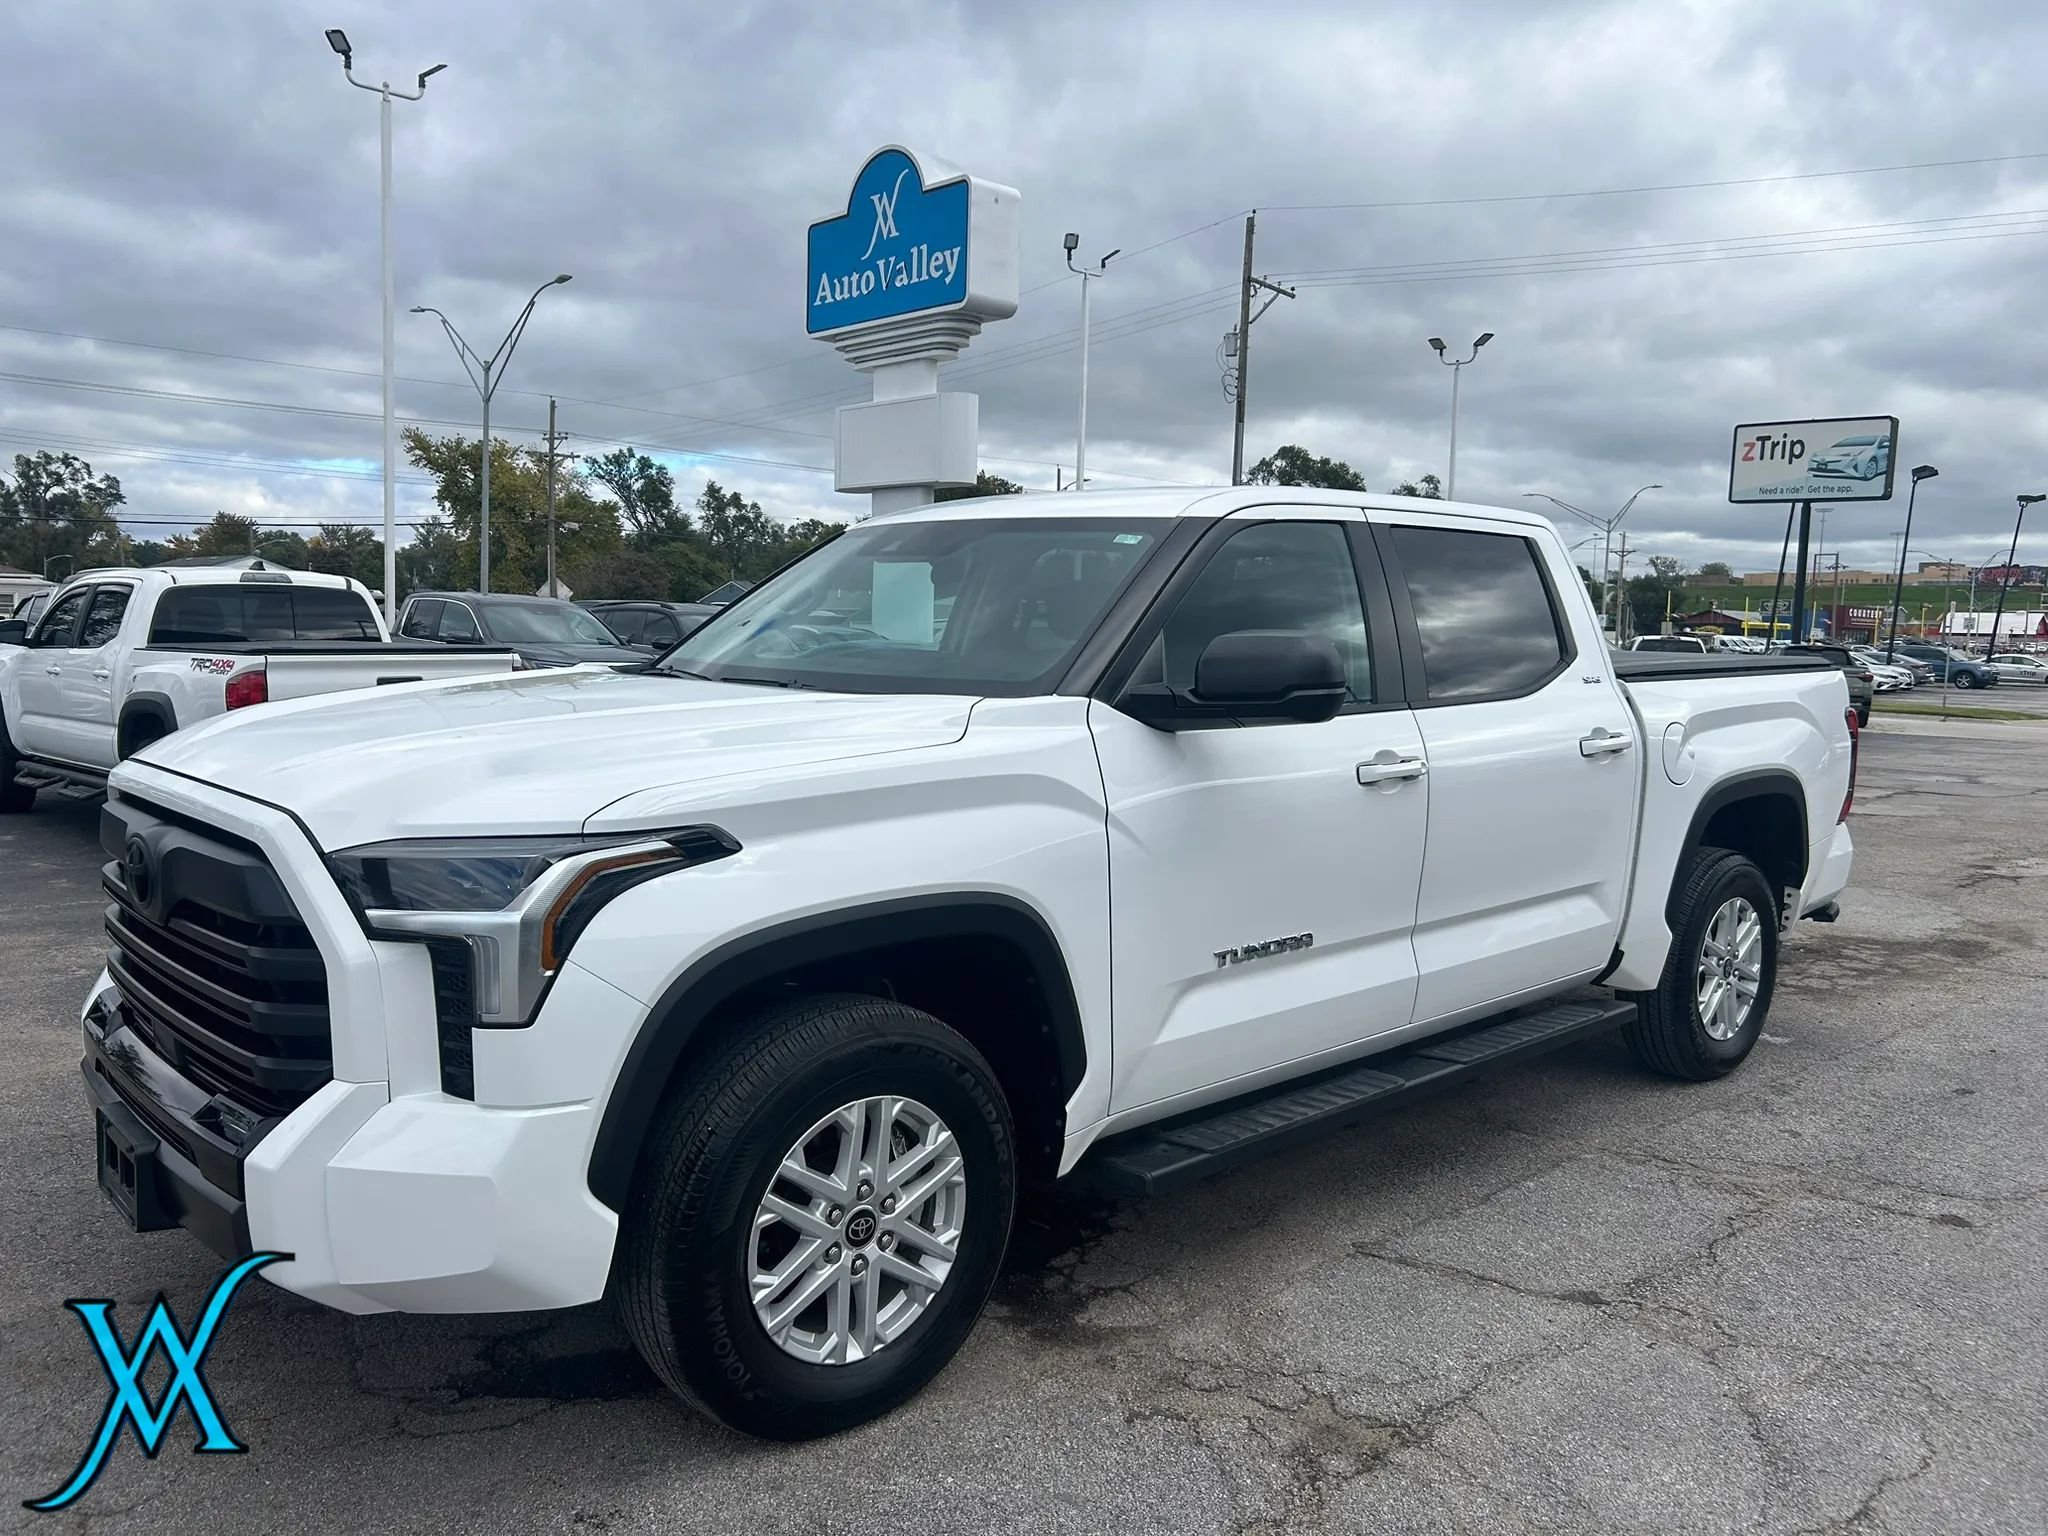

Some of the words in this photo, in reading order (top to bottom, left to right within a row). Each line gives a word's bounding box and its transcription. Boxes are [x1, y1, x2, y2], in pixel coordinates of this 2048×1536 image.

[1741, 433, 1806, 465] zTrip
[1759, 487, 1778, 495] Need
[1786, 486, 1803, 494] ride?
[1807, 485, 1821, 494] Get
[1822, 485, 1835, 493] the
[1836, 485, 1853, 495] app.
[1213, 931, 1314, 969] TUNDRA
